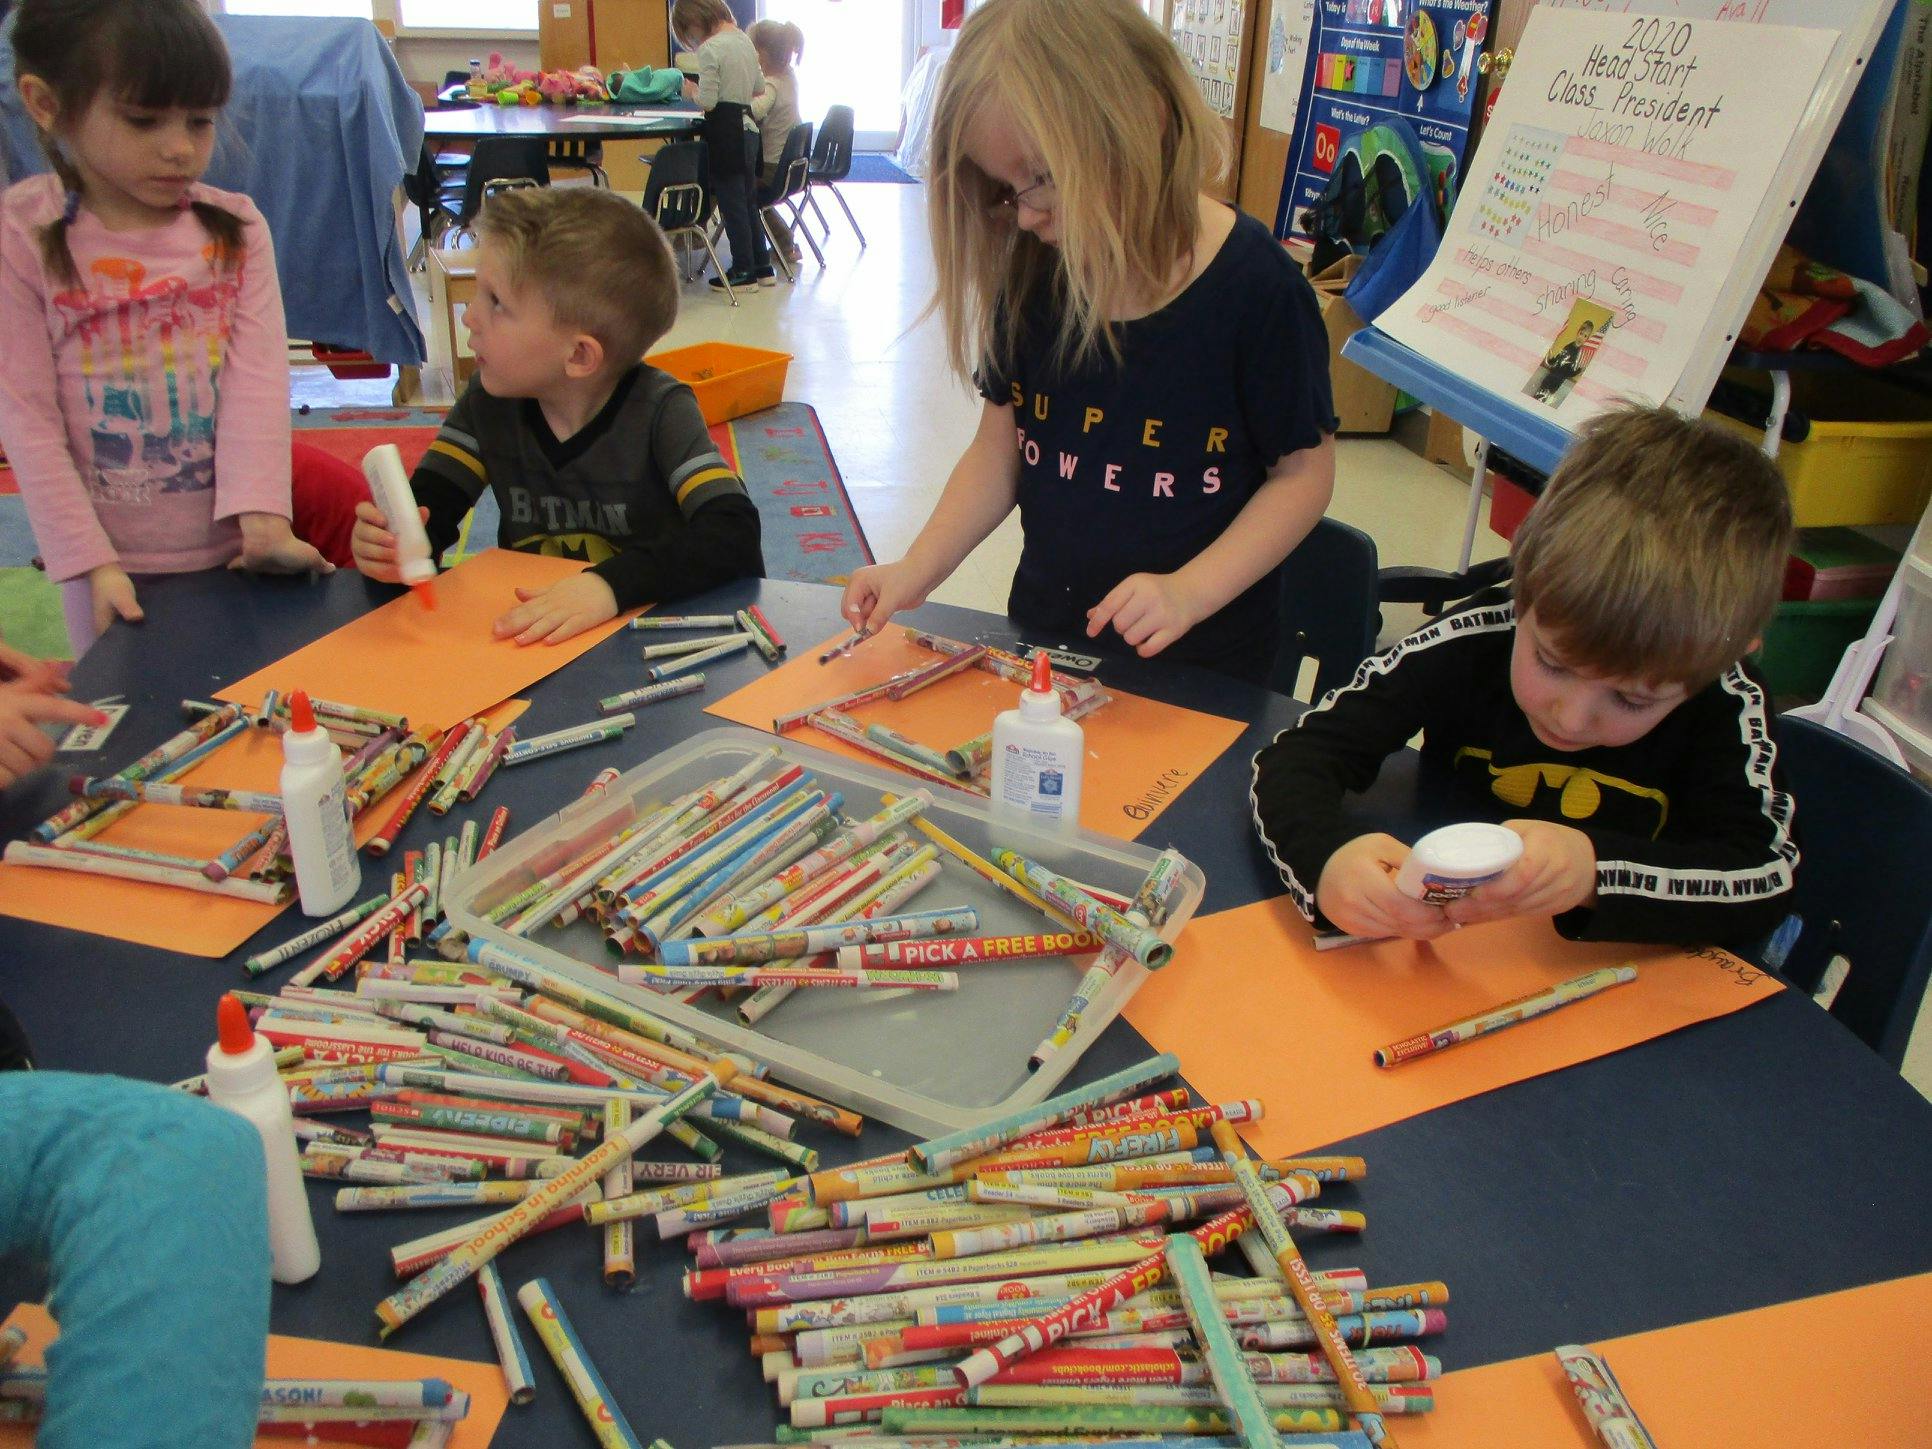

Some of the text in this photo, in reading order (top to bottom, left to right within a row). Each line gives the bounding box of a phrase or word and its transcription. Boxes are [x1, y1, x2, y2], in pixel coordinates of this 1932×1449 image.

[1453, 0, 1489, 13] Weather?
[1622, 17, 1692, 57] 2020
[1581, 44, 1697, 88] Head Start
[1547, 69, 1723, 129] Class President
[1315, 131, 1335, 163] Oo
[1420, 125, 1453, 141] Let's Count
[1577, 108, 1694, 161] Jaxon Wolk
[1537, 160, 1615, 242] Honest
[1640, 189, 1677, 252] Nice
[1463, 242, 1532, 285] Helps others
[1422, 285, 1492, 324] good listener
[1532, 268, 1597, 317] sharing
[1611, 266, 1639, 329] Caring
[1011, 380, 1229, 453] SUPER
[904, 943, 959, 965] PICK
[961, 942, 979, 960] A
[982, 935, 1036, 957] FREE
[1086, 1128, 1180, 1161] FIREFLY
[548, 1138, 622, 1196] Learning
[640, 1160, 692, 1179] VERY
[527, 1192, 546, 1210] in
[468, 1207, 530, 1257] School
[729, 1264, 765, 1278] Every
[968, 1261, 1004, 1273] Paperbacks
[1046, 1297, 1103, 1341] PICK
